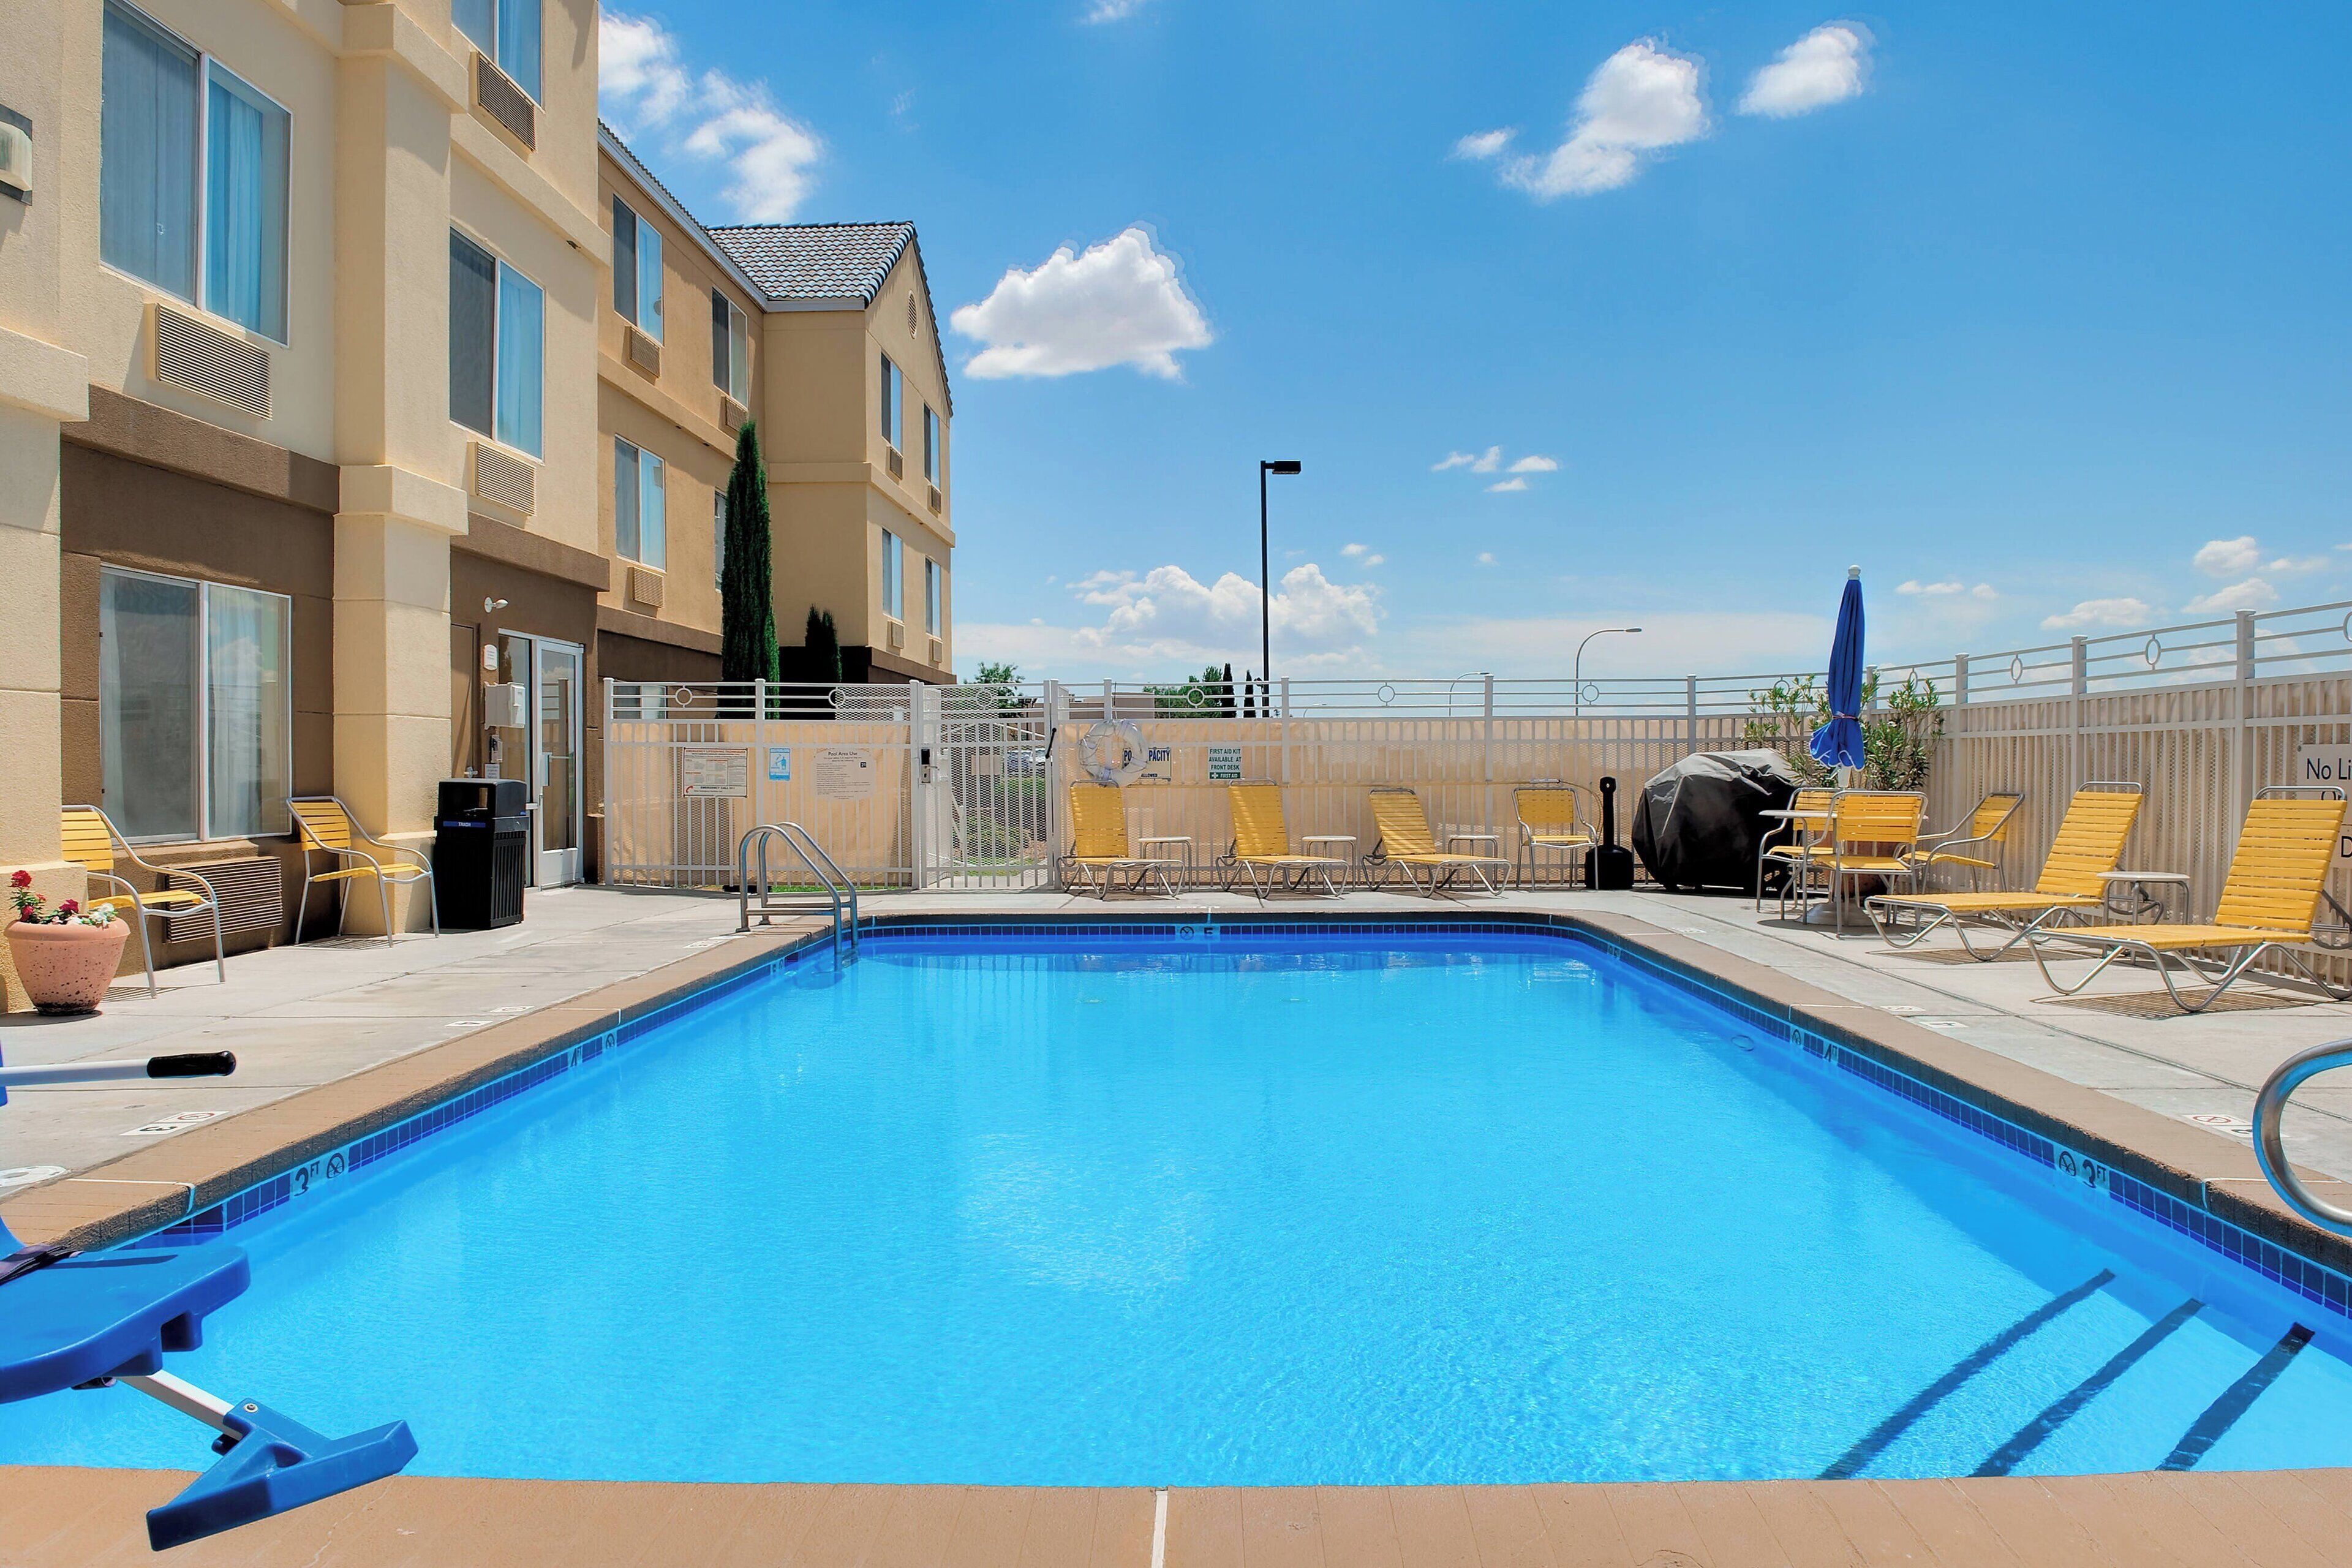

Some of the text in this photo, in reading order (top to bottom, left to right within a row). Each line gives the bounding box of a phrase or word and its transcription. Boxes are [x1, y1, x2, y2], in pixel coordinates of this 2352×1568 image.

[1148, 750, 1170, 761] PACITY
[2307, 758, 2352, 780] No Li
[2341, 835, 2352, 858] D
[311, 1160, 320, 1177] FT
[2097, 1165, 2106, 1182] FT
